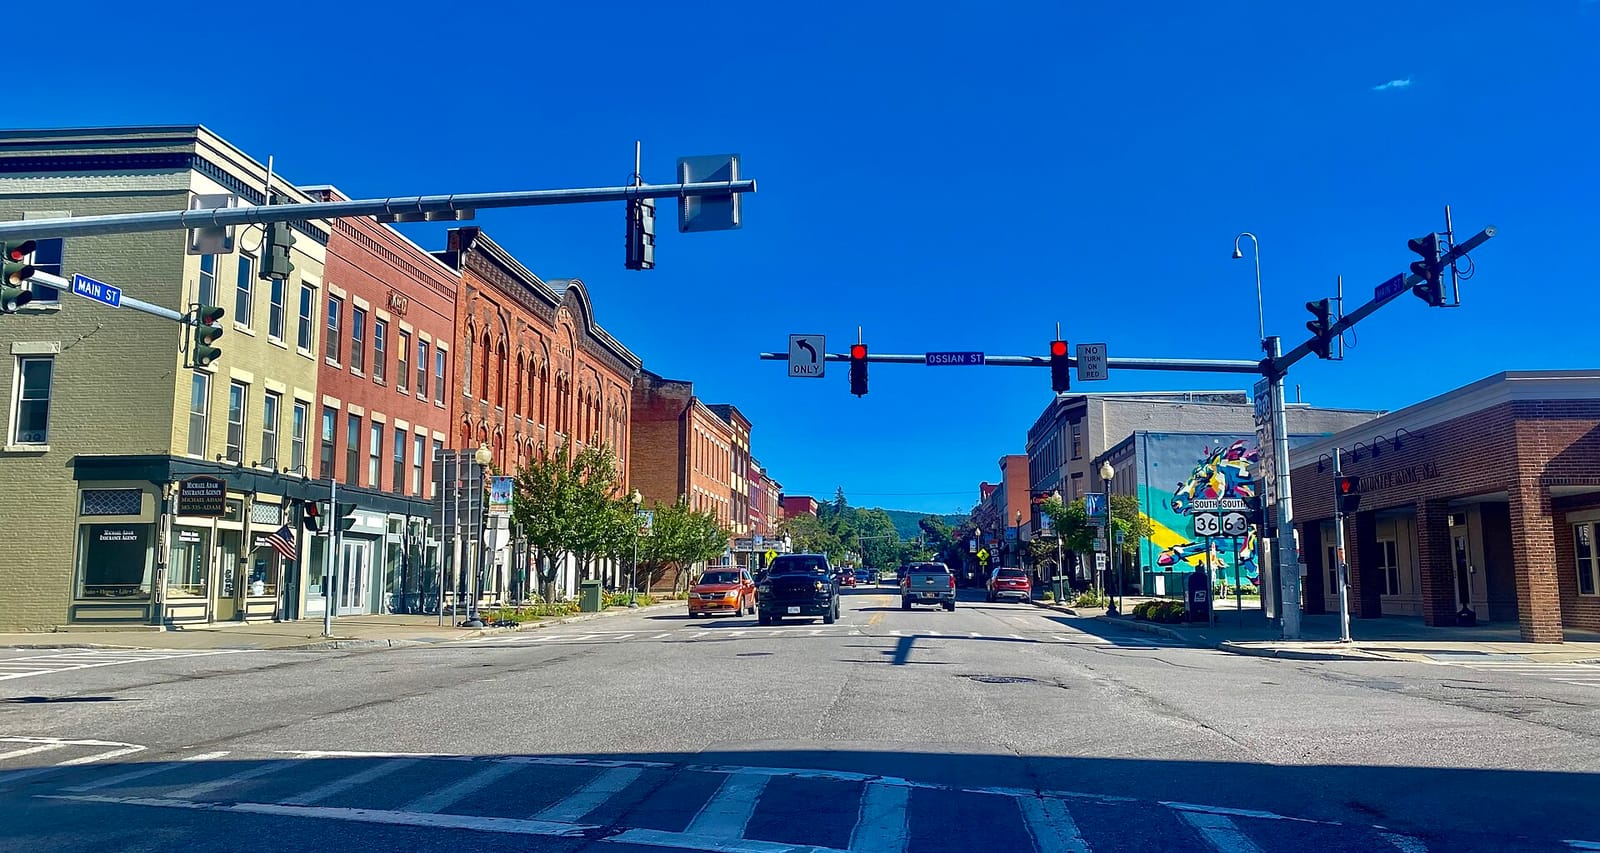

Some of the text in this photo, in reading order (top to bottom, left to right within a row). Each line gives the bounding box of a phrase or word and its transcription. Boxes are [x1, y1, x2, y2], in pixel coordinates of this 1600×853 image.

[78, 279, 117, 302] MAIN ST
[1376, 278, 1401, 298] MAIN ST
[1085, 346, 1098, 355] NO
[929, 354, 982, 363] OSSIAN ST
[793, 365, 819, 374] ONLY
[1194, 500, 1218, 508] SOUTH
[1222, 500, 1246, 508] SOUTH
[1197, 517, 1217, 531] 36
[1224, 517, 1246, 531] 63
